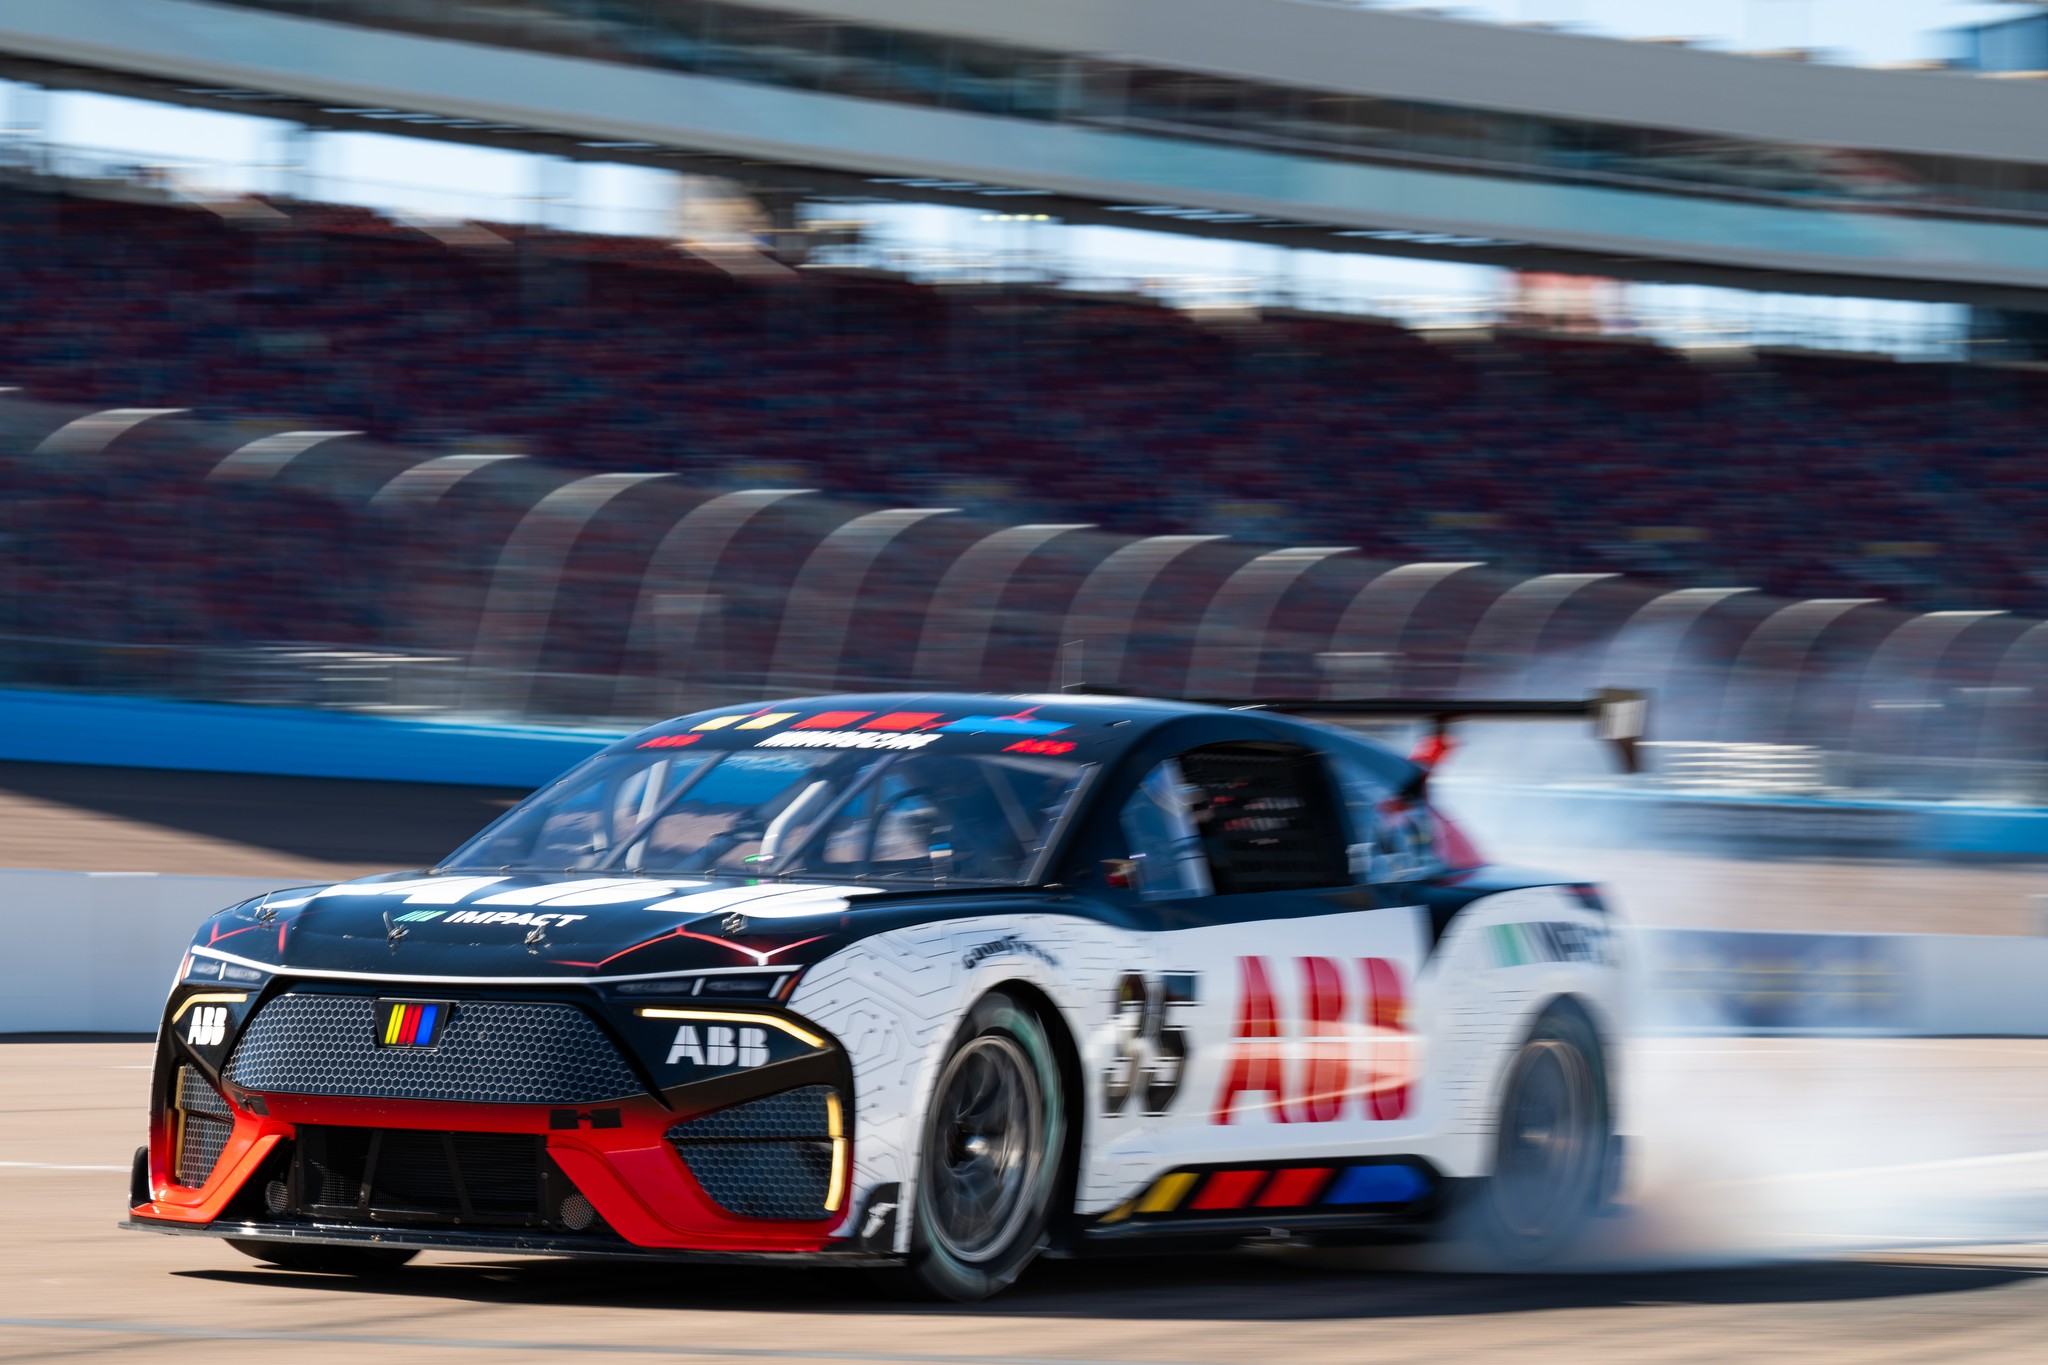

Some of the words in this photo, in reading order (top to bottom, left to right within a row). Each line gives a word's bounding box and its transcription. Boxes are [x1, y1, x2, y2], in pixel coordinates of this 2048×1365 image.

[442, 910, 588, 927] IMPACT
[963, 938, 1061, 969] GOOD
[188, 1006, 227, 1046] ABB
[665, 1025, 770, 1067] ABB
[1211, 956, 1416, 1125] ABB
